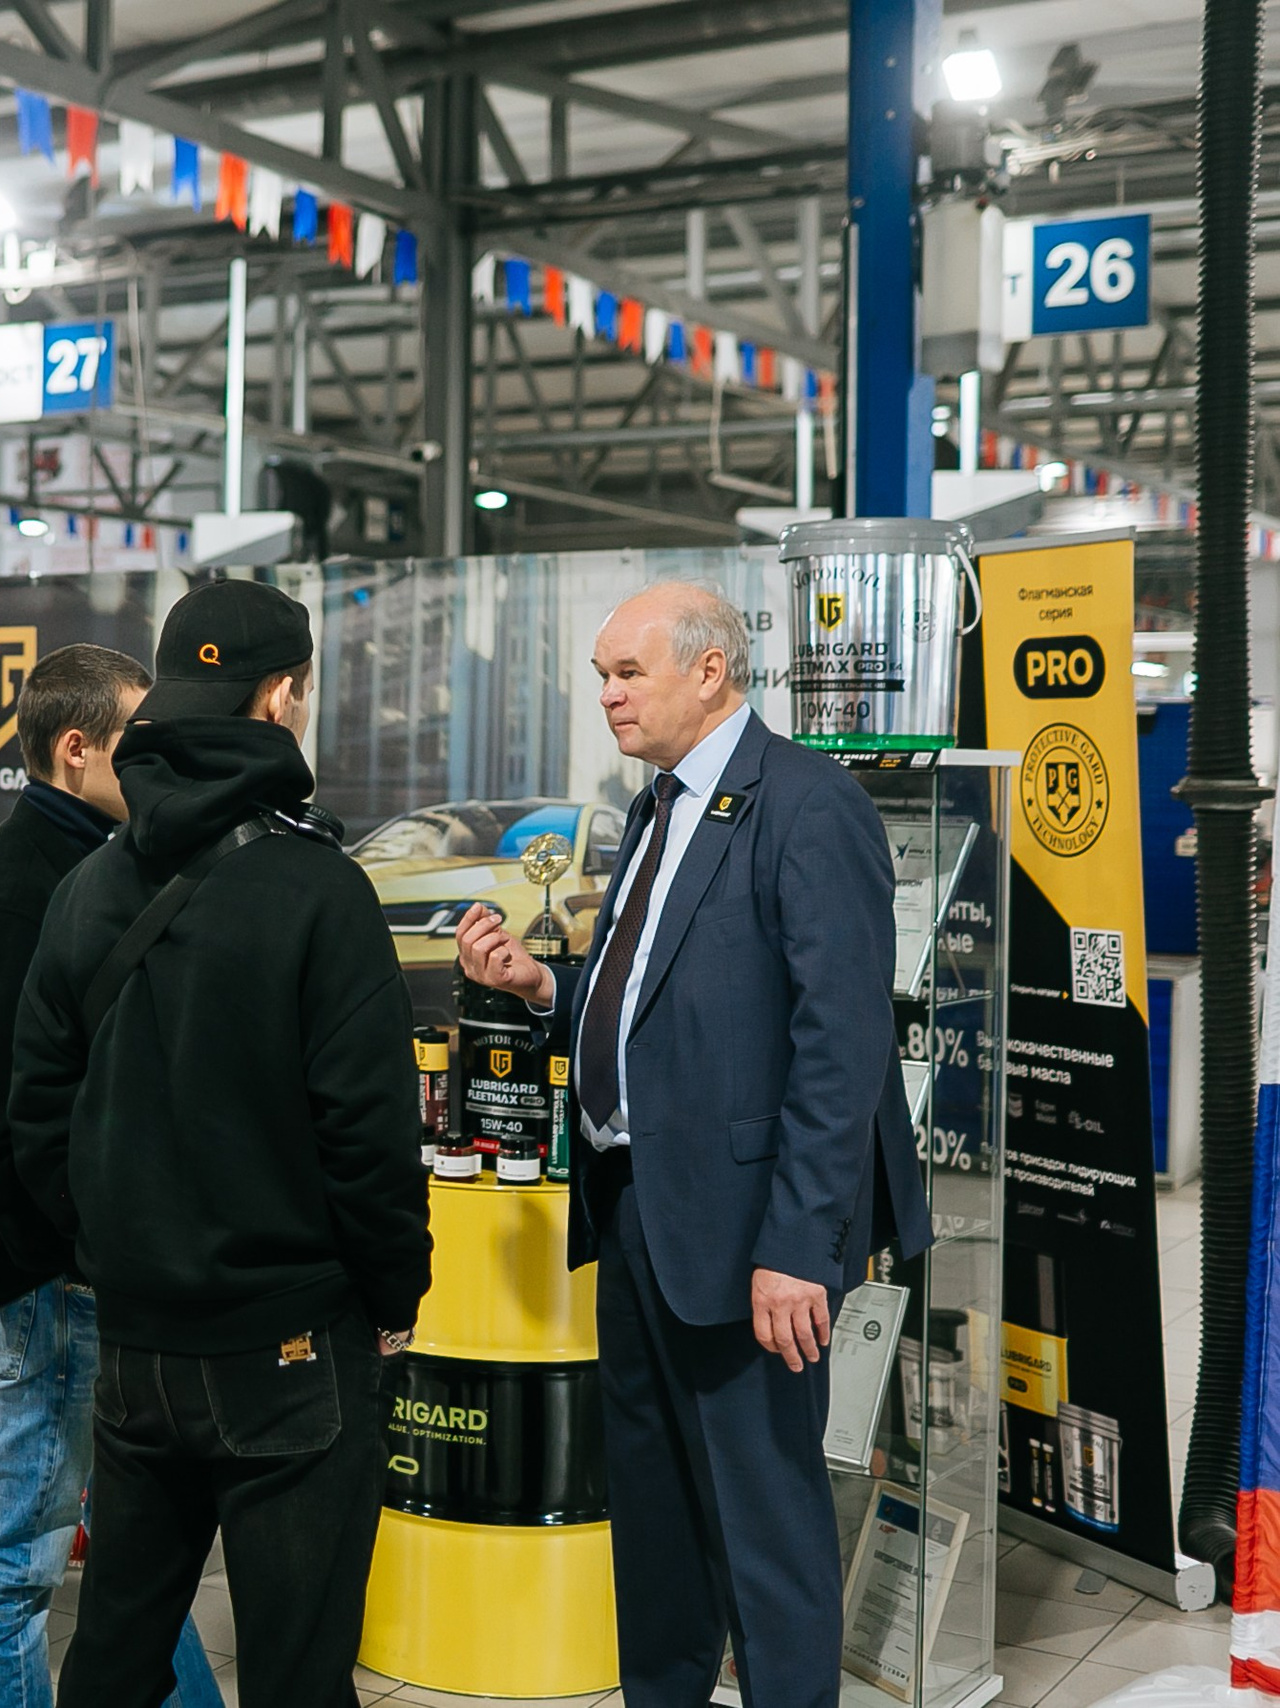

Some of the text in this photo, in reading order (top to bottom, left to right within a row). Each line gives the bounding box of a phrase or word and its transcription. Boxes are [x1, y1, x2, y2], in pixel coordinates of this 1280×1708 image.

[1044, 238, 1135, 308] 26
[46, 338, 107, 394] 27
[1018, 584, 1094, 601] Флагманская
[1038, 606, 1073, 623] серия
[199, 643, 221, 666] Q
[793, 641, 889, 658] LUBRIGARD
[1026, 648, 1094, 687] PRO
[801, 701, 870, 719] 10W-40
[1024, 729, 1104, 786] PROTECTIVE GARD
[1032, 814, 1100, 851] TECHNOLOGY
[473, 1034, 512, 1047] MOTOR
[907, 1023, 969, 1067] 80%
[471, 1078, 539, 1095] LUBRIGARD
[1031, 1065, 1072, 1085] масла
[468, 1089, 519, 1105] FLEETMAX
[480, 1118, 523, 1134] 15W-40
[914, 1126, 971, 1171] 20%
[1020, 1152, 1066, 1171] присадок
[1068, 1163, 1137, 1188] лидирующих
[393, 1397, 487, 1431] RIGARD
[388, 1422, 487, 1446] ALUE. OPTIMIZATION.
